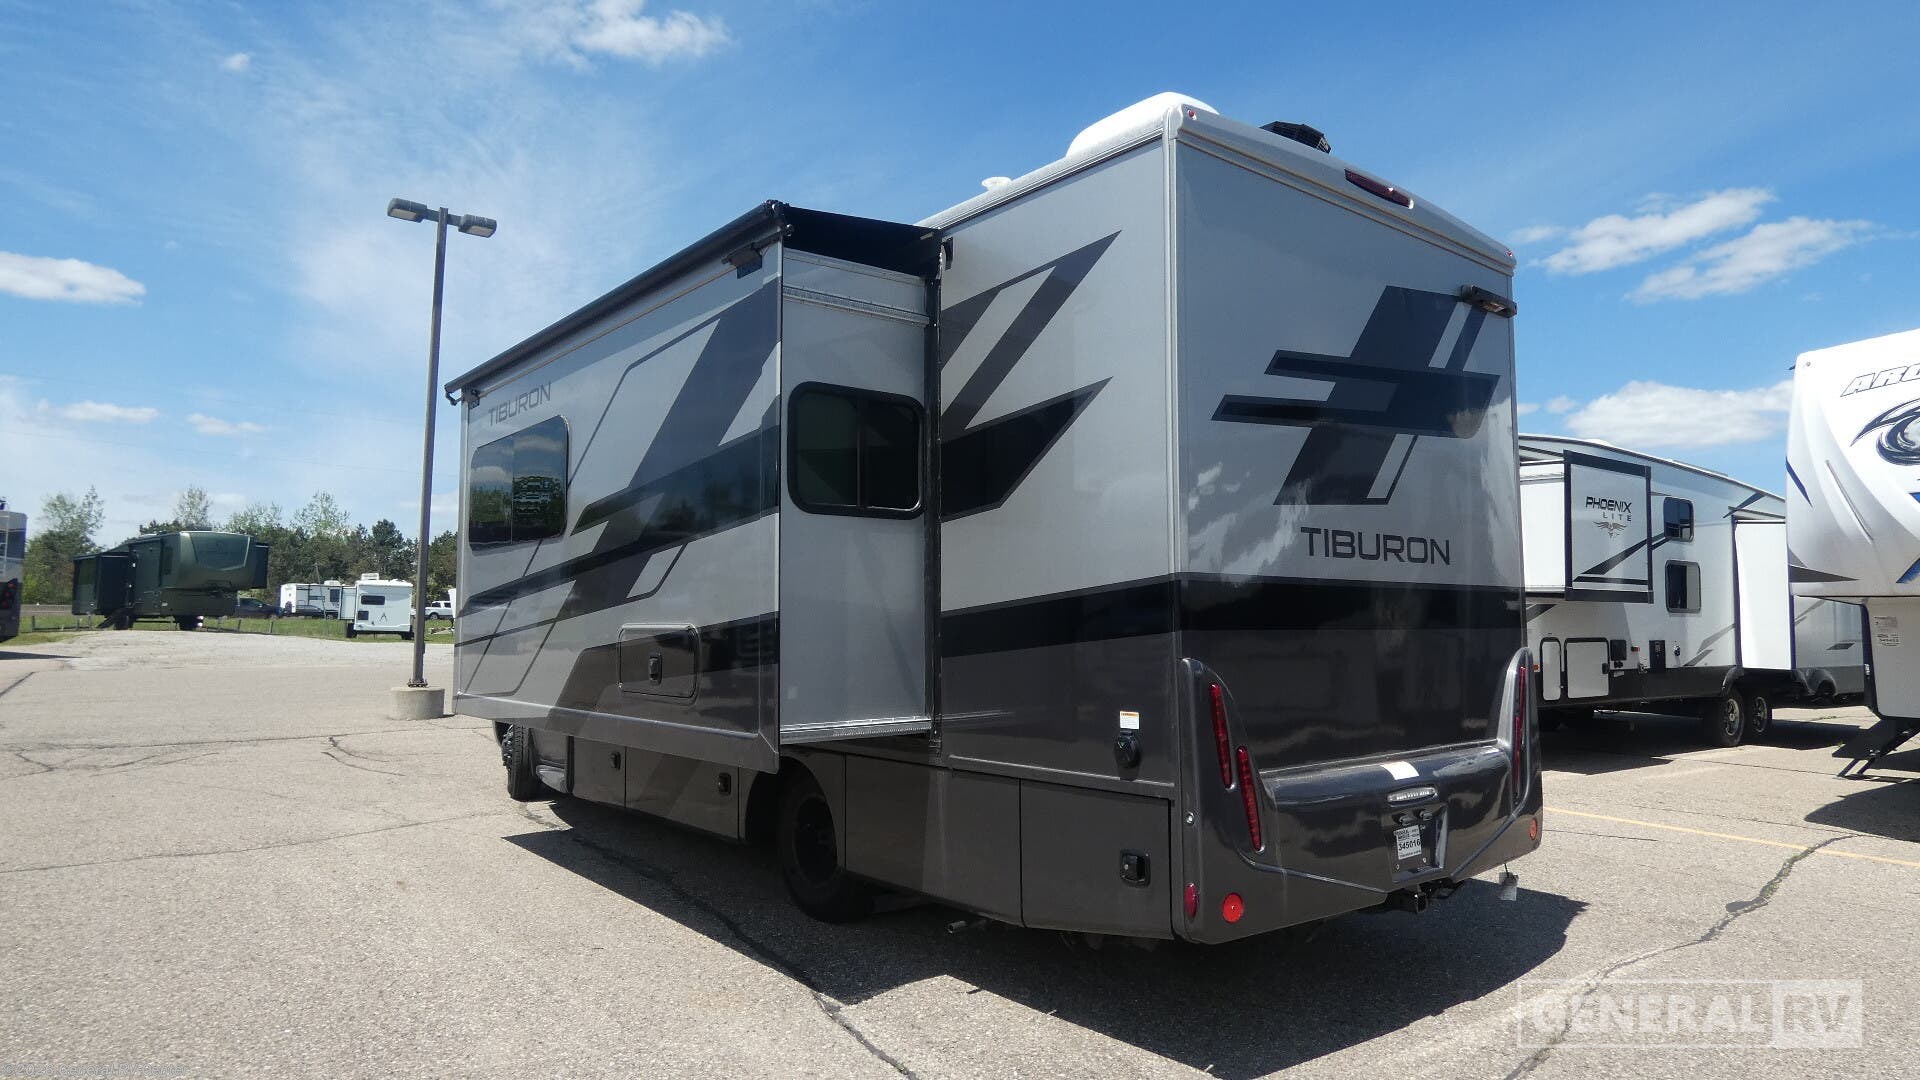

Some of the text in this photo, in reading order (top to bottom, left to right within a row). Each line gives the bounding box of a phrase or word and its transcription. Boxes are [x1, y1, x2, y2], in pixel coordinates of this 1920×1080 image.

[487, 380, 552, 427] TIBURON
[1585, 496, 1632, 514] PHOENIX
[1602, 511, 1632, 522] LITE
[1300, 526, 1451, 566] TIBURON
